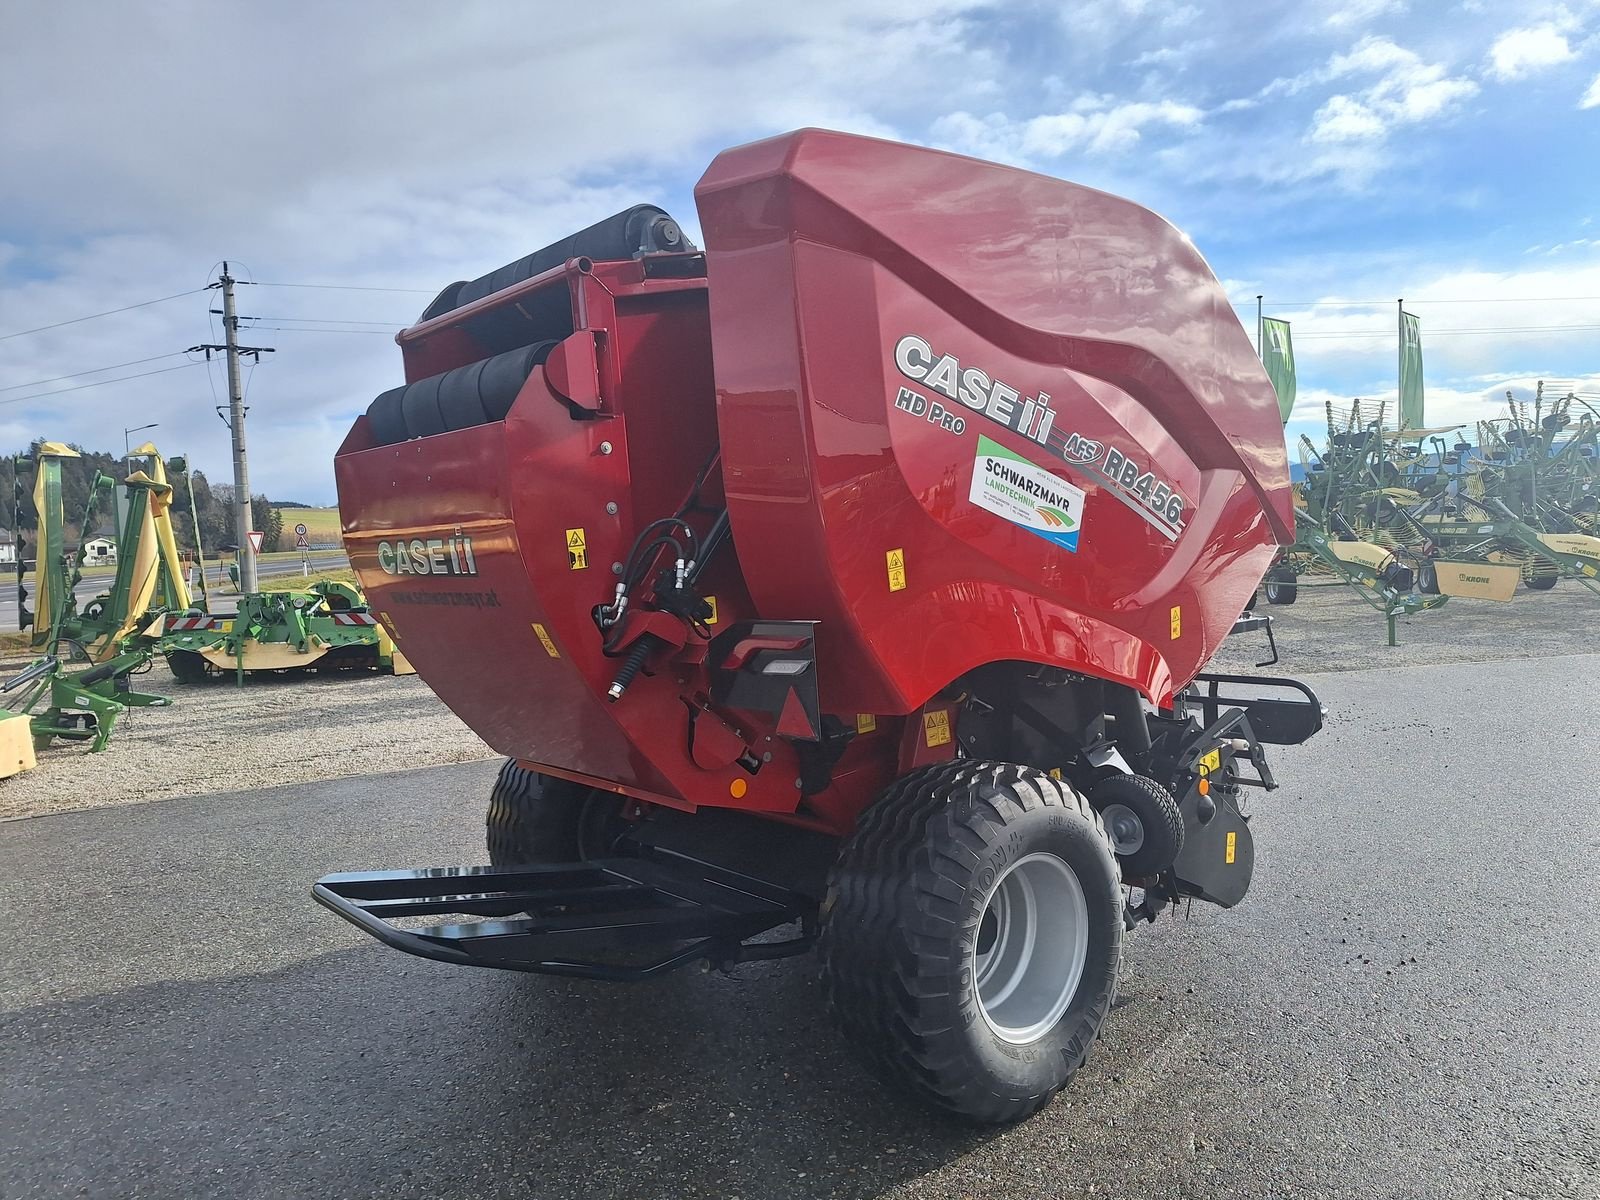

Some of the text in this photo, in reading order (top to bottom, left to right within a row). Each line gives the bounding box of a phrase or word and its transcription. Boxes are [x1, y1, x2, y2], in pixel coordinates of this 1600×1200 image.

[894, 334, 1020, 427] CASE
[894, 386, 928, 418] HD
[984, 475, 1037, 510] LANDTECHNIK
[985, 457, 1071, 513] SCHWARZMAYR
[1063, 432, 1186, 525] AFS RB456
[377, 539, 450, 576] CASE
[1358, 558, 1377, 567] KRONE
[1577, 549, 1600, 557] KRONE
[1465, 576, 1491, 584] KRONE
